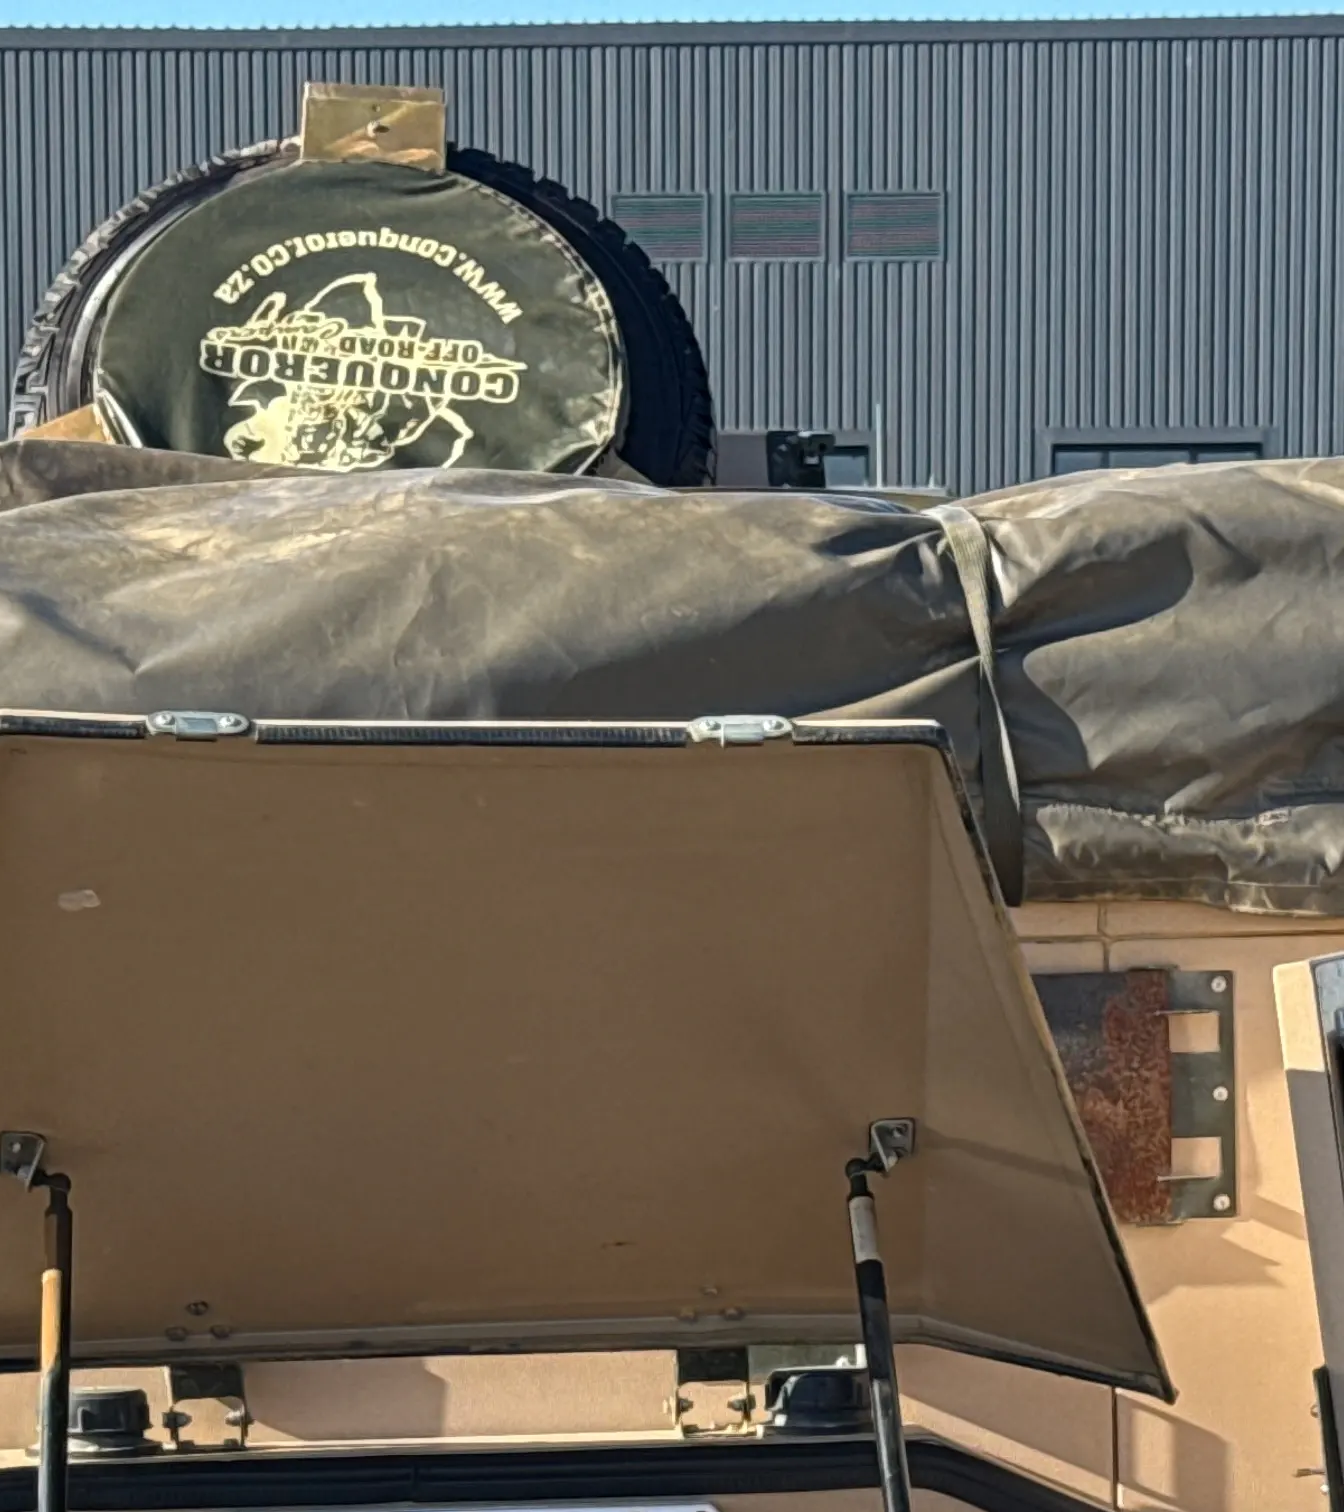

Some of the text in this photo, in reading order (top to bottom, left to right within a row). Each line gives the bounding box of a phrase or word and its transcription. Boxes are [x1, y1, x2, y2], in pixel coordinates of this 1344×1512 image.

[213, 226, 524, 324] www.conqueror.co.za
[203, 343, 518, 399] CONQUEROR
[339, 335, 482, 363] OFF-ROAD
